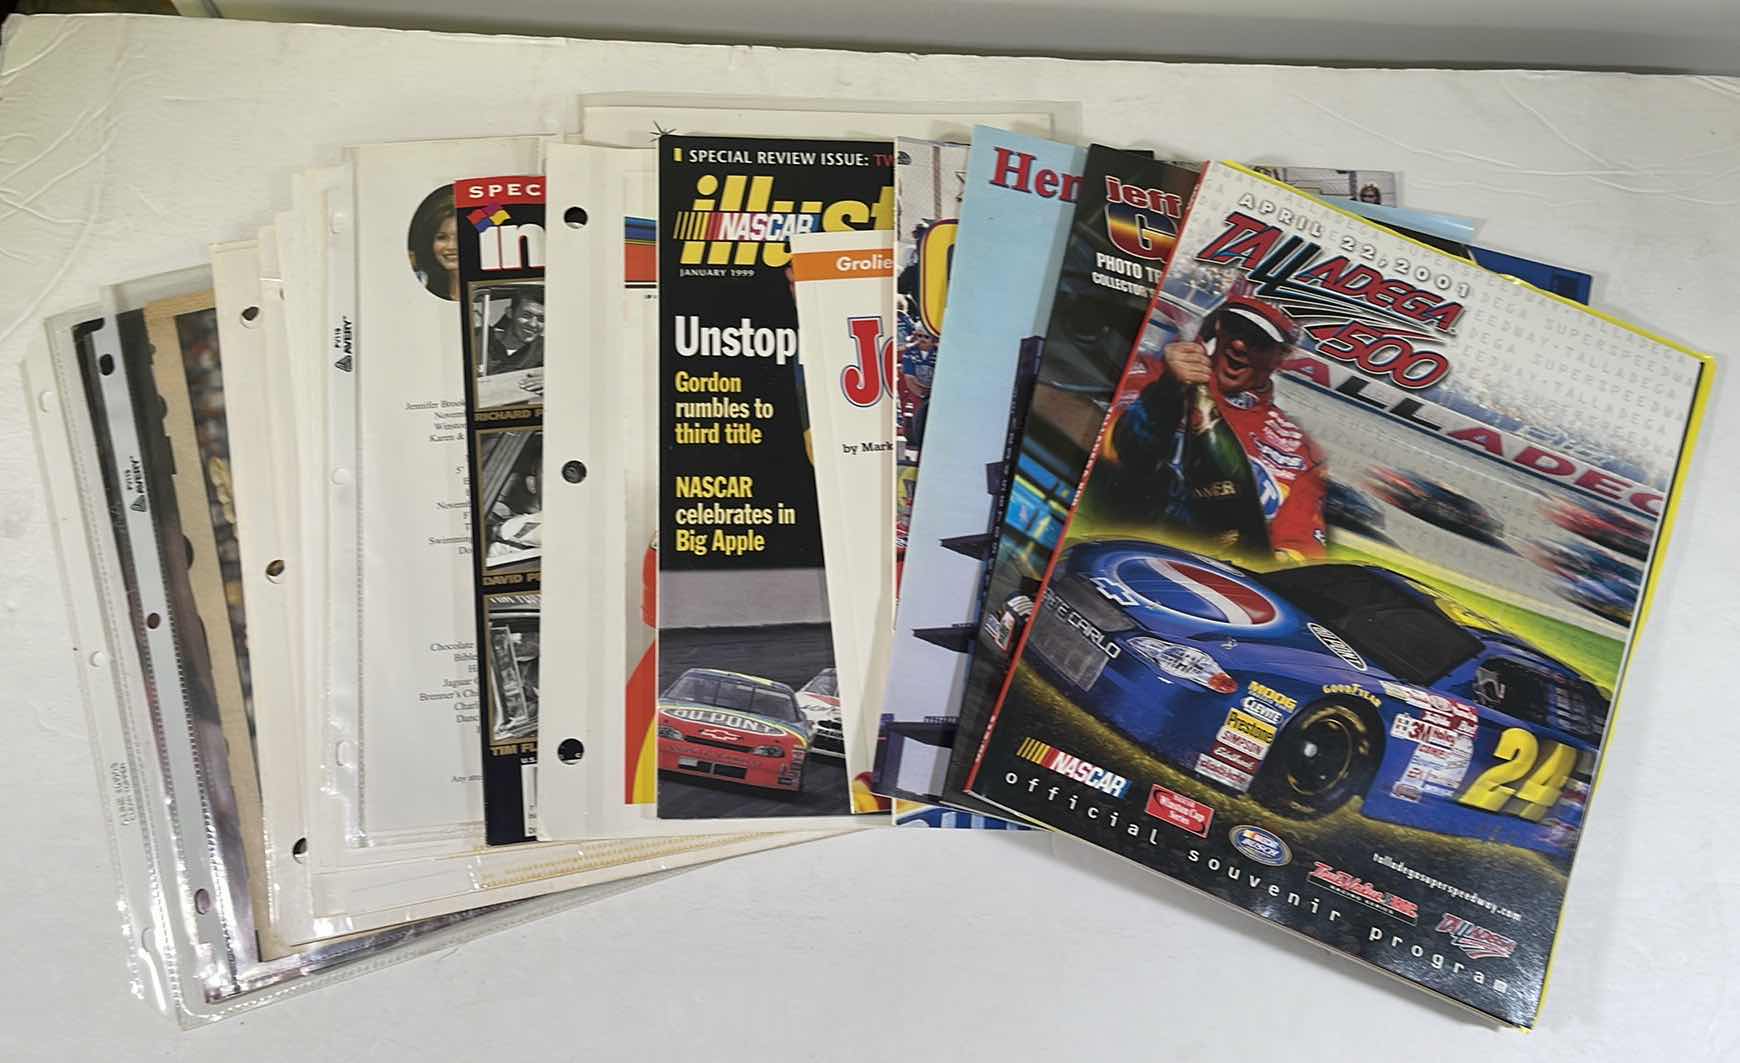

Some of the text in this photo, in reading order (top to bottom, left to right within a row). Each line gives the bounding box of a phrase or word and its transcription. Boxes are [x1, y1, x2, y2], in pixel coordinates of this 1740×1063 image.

[689, 150, 753, 167] SPECIAL
[757, 151, 817, 168] REVIEW
[821, 153, 869, 170] ISSUE:
[469, 183, 541, 199] SPEC
[1105, 175, 1183, 220] jeff
[1239, 193, 1323, 239] APRIL
[680, 268, 756, 281] JANUARY 1999
[1096, 252, 1144, 280] PHOTO
[1195, 211, 1468, 337] TALLADEGA
[342, 320, 353, 355] AVERY
[674, 316, 799, 366] Unstop
[1308, 321, 1451, 391] 500
[675, 371, 742, 393] Gordon
[475, 409, 530, 423] RICHARD
[675, 397, 775, 419] rumbles to
[675, 422, 763, 445] third title
[842, 441, 894, 456] by Mark
[675, 476, 753, 498] NASCAR
[675, 502, 796, 525] celebrates in
[676, 529, 767, 556] Big Apple
[482, 576, 524, 587] DAVID
[1068, 611, 1121, 659] CARLO
[1248, 680, 1298, 712] MOOG
[1228, 710, 1277, 744] Prestone
[490, 744, 518, 757] TIM
[1046, 749, 1131, 801] NASCAR
[1457, 726, 1578, 823] 24
[1004, 771, 1158, 847] official
[1187, 848, 1341, 922] souvenir
